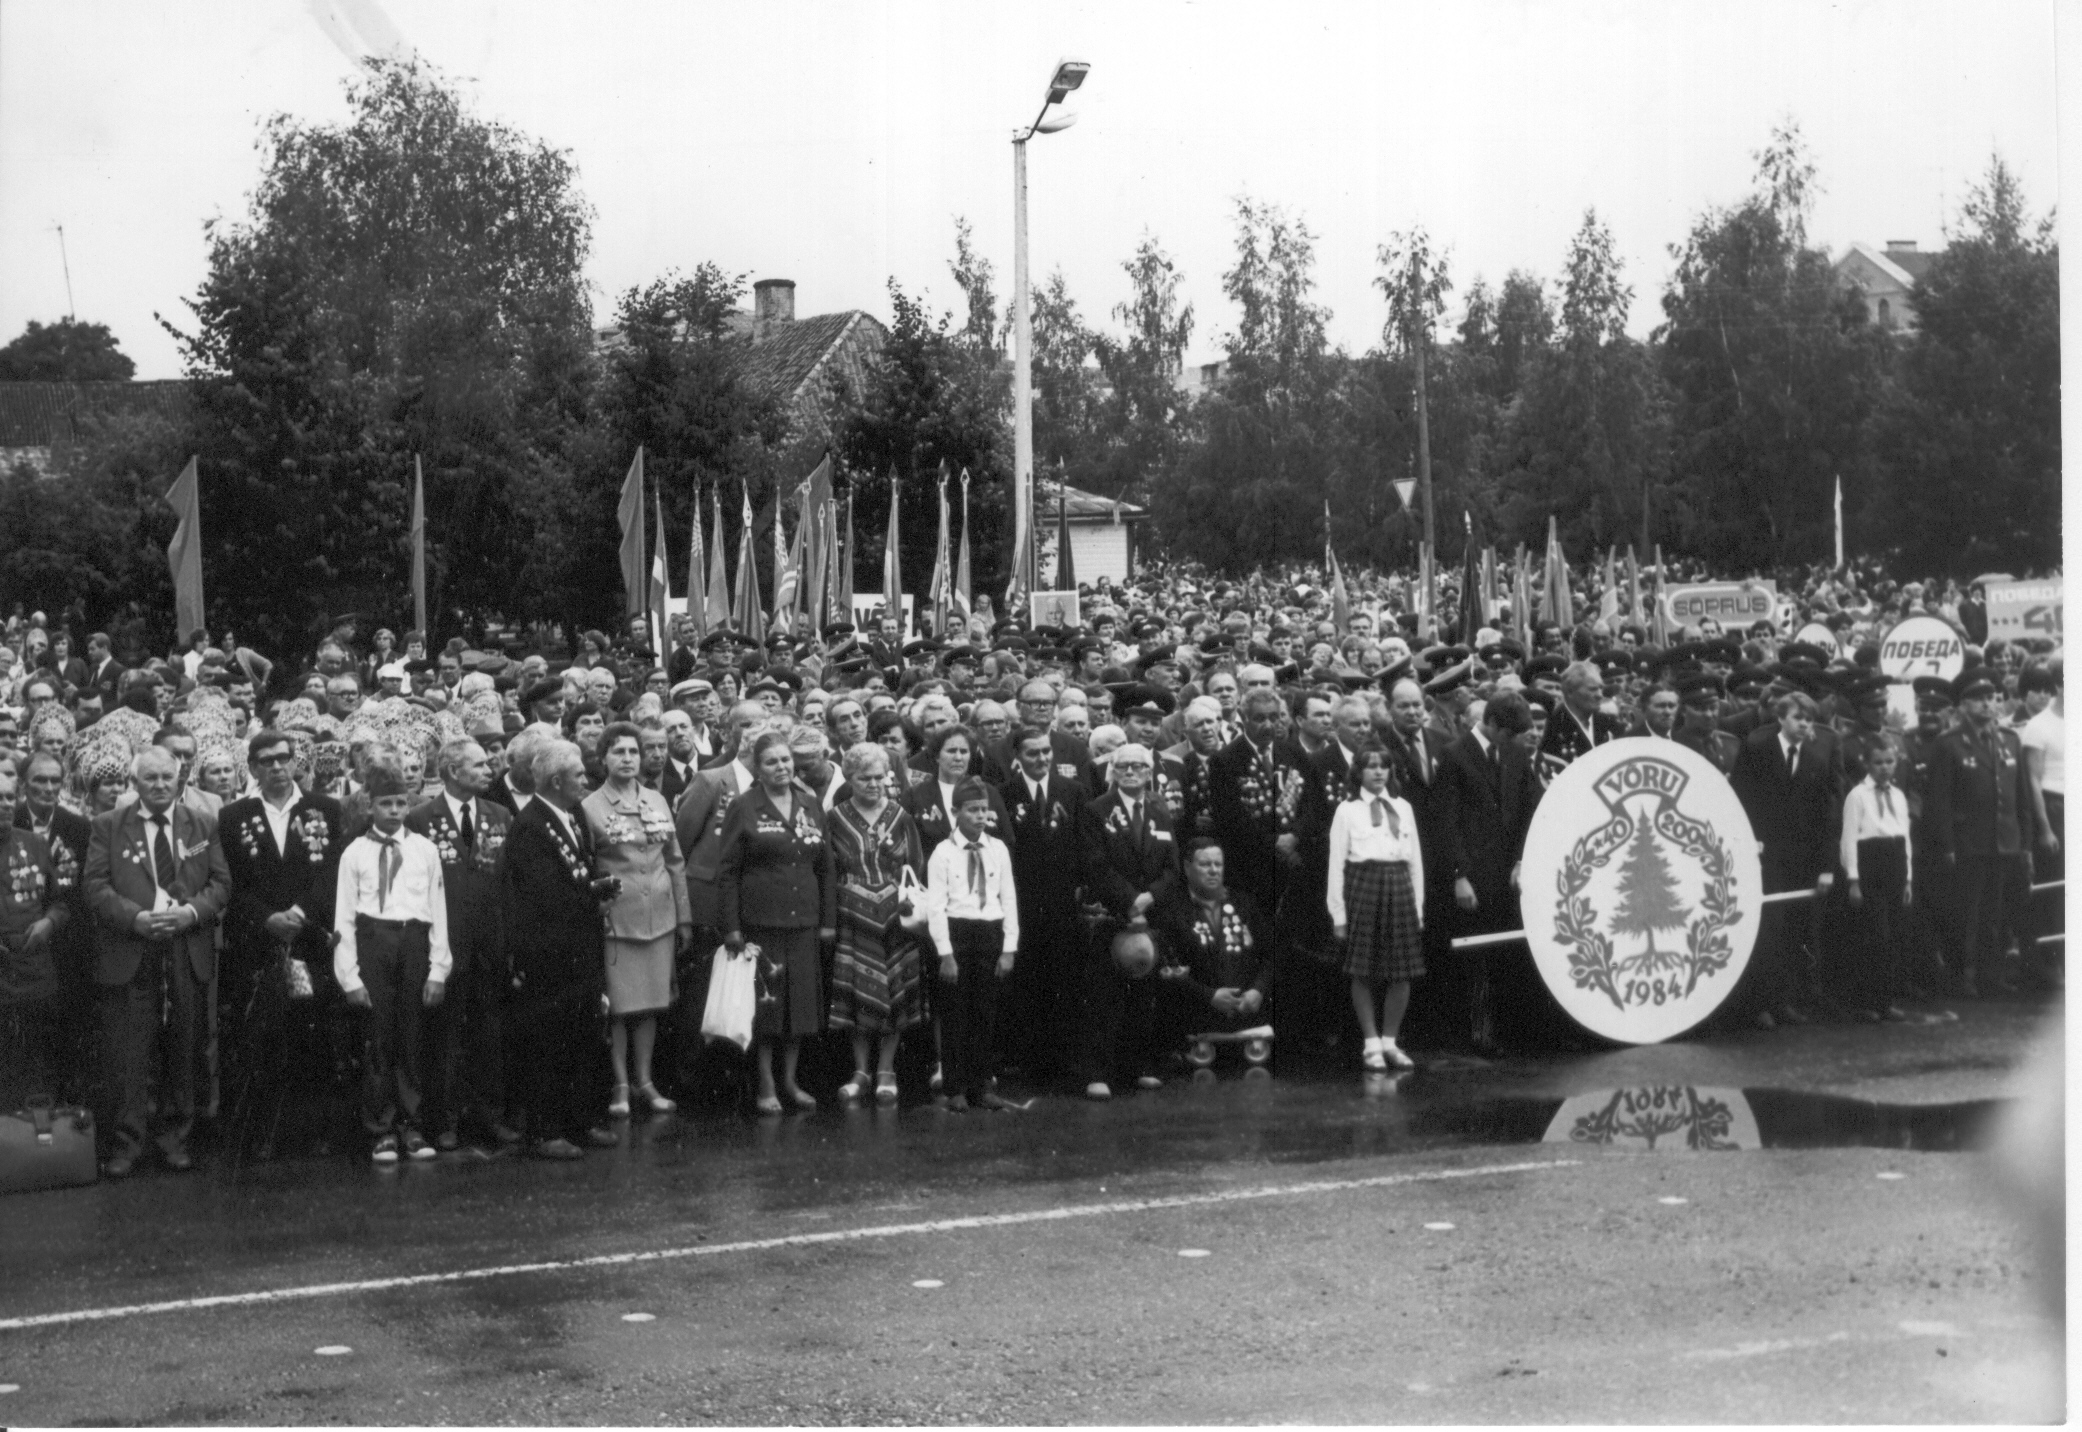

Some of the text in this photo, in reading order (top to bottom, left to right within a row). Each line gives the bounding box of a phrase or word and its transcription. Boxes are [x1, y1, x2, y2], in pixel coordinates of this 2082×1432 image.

[1883, 639, 1960, 659] ПОБЕДА
[1604, 762, 1680, 794] VÕRU
[1661, 813, 1701, 844] 200
[1623, 973, 1683, 1006] 1984
